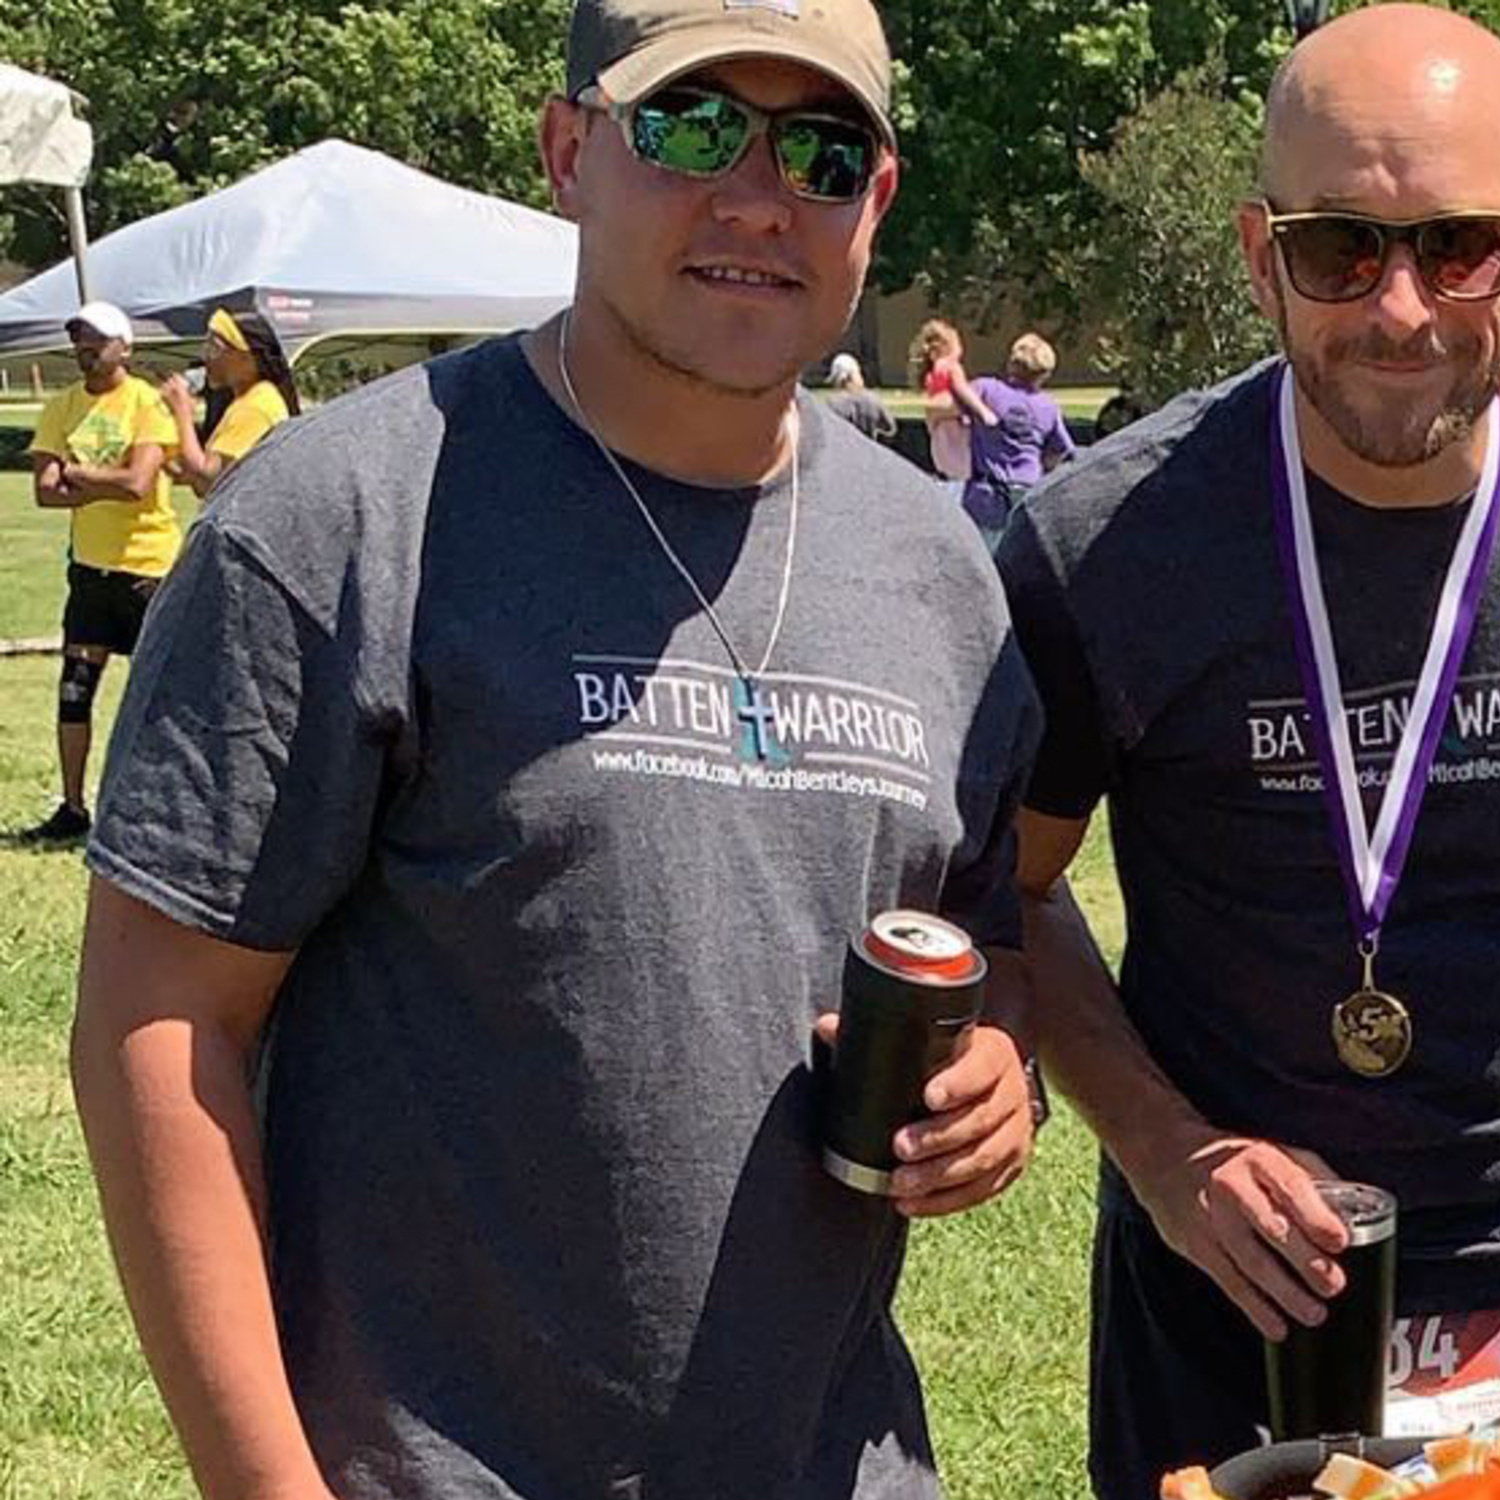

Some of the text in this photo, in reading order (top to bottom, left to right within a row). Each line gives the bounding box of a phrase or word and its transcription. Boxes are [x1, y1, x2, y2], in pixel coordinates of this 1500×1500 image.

[575, 673, 930, 767] BATTEN WARRIOR
[1247, 697, 1412, 760] BAEN
